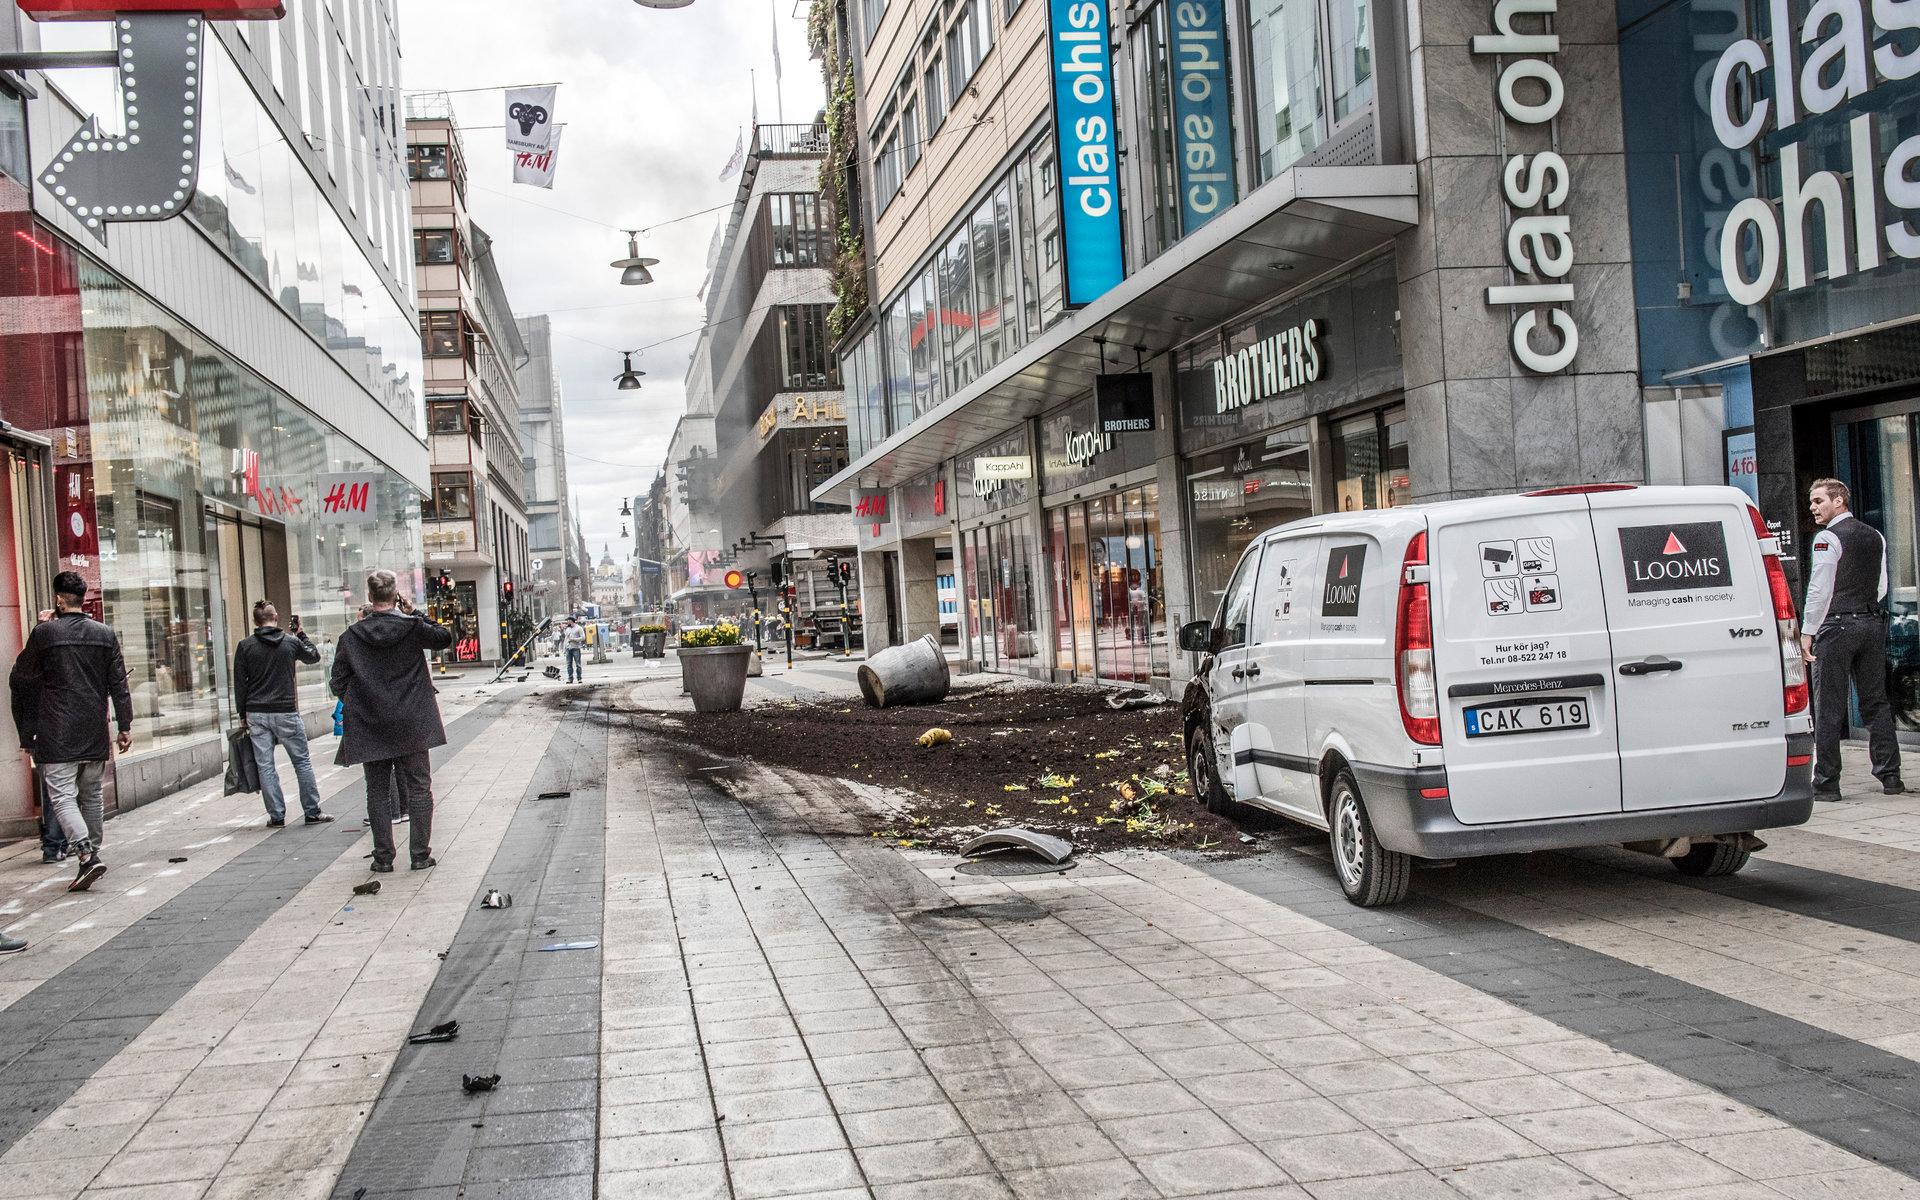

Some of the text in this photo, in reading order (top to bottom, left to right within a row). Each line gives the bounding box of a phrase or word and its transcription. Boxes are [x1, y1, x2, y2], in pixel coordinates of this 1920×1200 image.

[1710, 0, 1920, 149] clas
[1059, 2, 1112, 217] clas ohls
[515, 150, 553, 172] H&M
[1474, 0, 1579, 373] clas oh
[1720, 113, 1920, 305] ohls
[1213, 318, 1321, 414] BROTHERS
[1104, 418, 1150, 431] BROTHERS
[986, 462, 1024, 473] KappAhl
[1732, 458, 1739, 476] 4
[323, 482, 369, 514] H&M
[855, 495, 886, 518] H&M
[1633, 557, 1720, 581] LOOMIS
[1325, 583, 1357, 604] LOOMIS
[1628, 592, 1735, 608] Managing cash in society.
[456, 639, 478, 653] H&M
[1495, 641, 1550, 653] Hur kör jag?
[1481, 656, 1505, 665] Tel.nr
[1507, 653, 1536, 663] 08-522
[1539, 652, 1554, 660] 247
[1493, 680, 1563, 693] Mercedes-Benz
[1481, 704, 1582, 731] CAK 619
